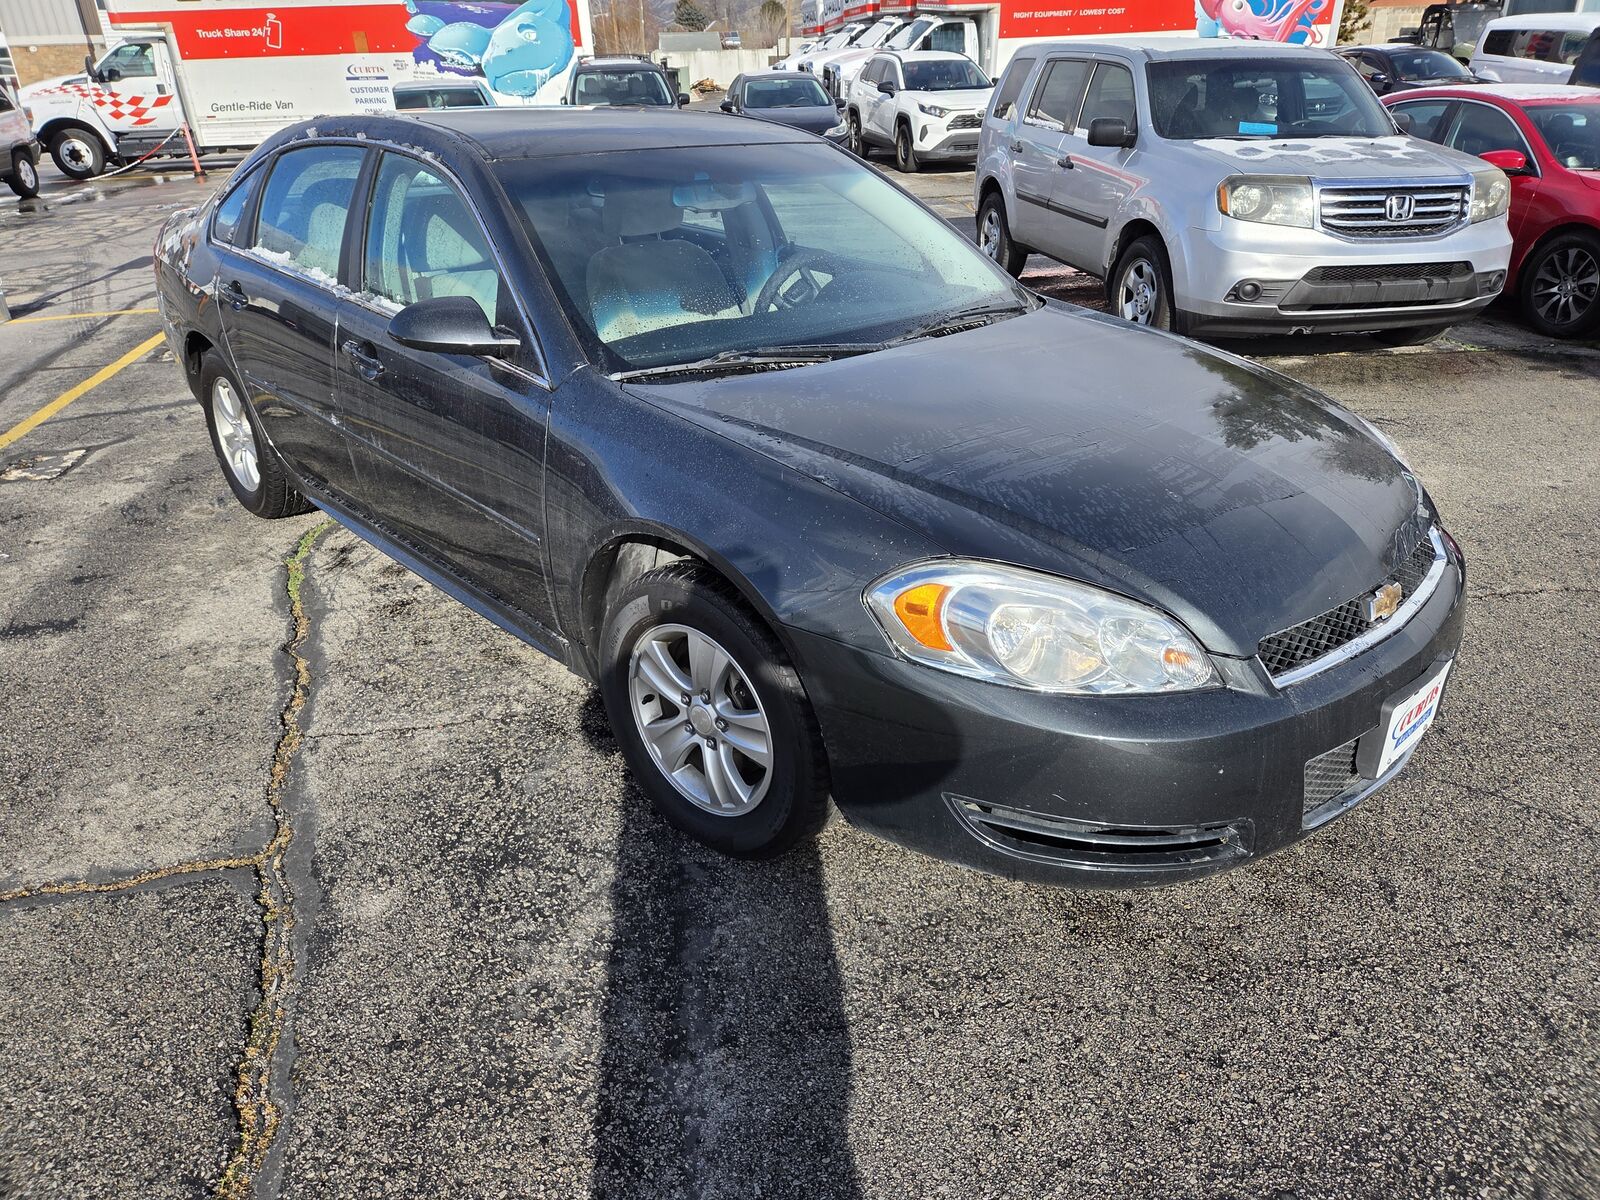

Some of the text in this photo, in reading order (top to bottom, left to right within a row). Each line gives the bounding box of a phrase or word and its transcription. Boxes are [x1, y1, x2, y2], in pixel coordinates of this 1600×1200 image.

[1013, 11, 1034, 19] RIGHT
[1034, 9, 1073, 18] EQUIPMENT
[1079, 8, 1106, 16] LOWEST
[1107, 7, 1126, 15] COST
[196, 26, 271, 38] Truck Share 24/7
[353, 66, 385, 74] CURTIS
[350, 86, 389, 94] CUSTOMER
[211, 99, 294, 112] Gentle-Ride Van
[355, 97, 387, 105] PARKING
